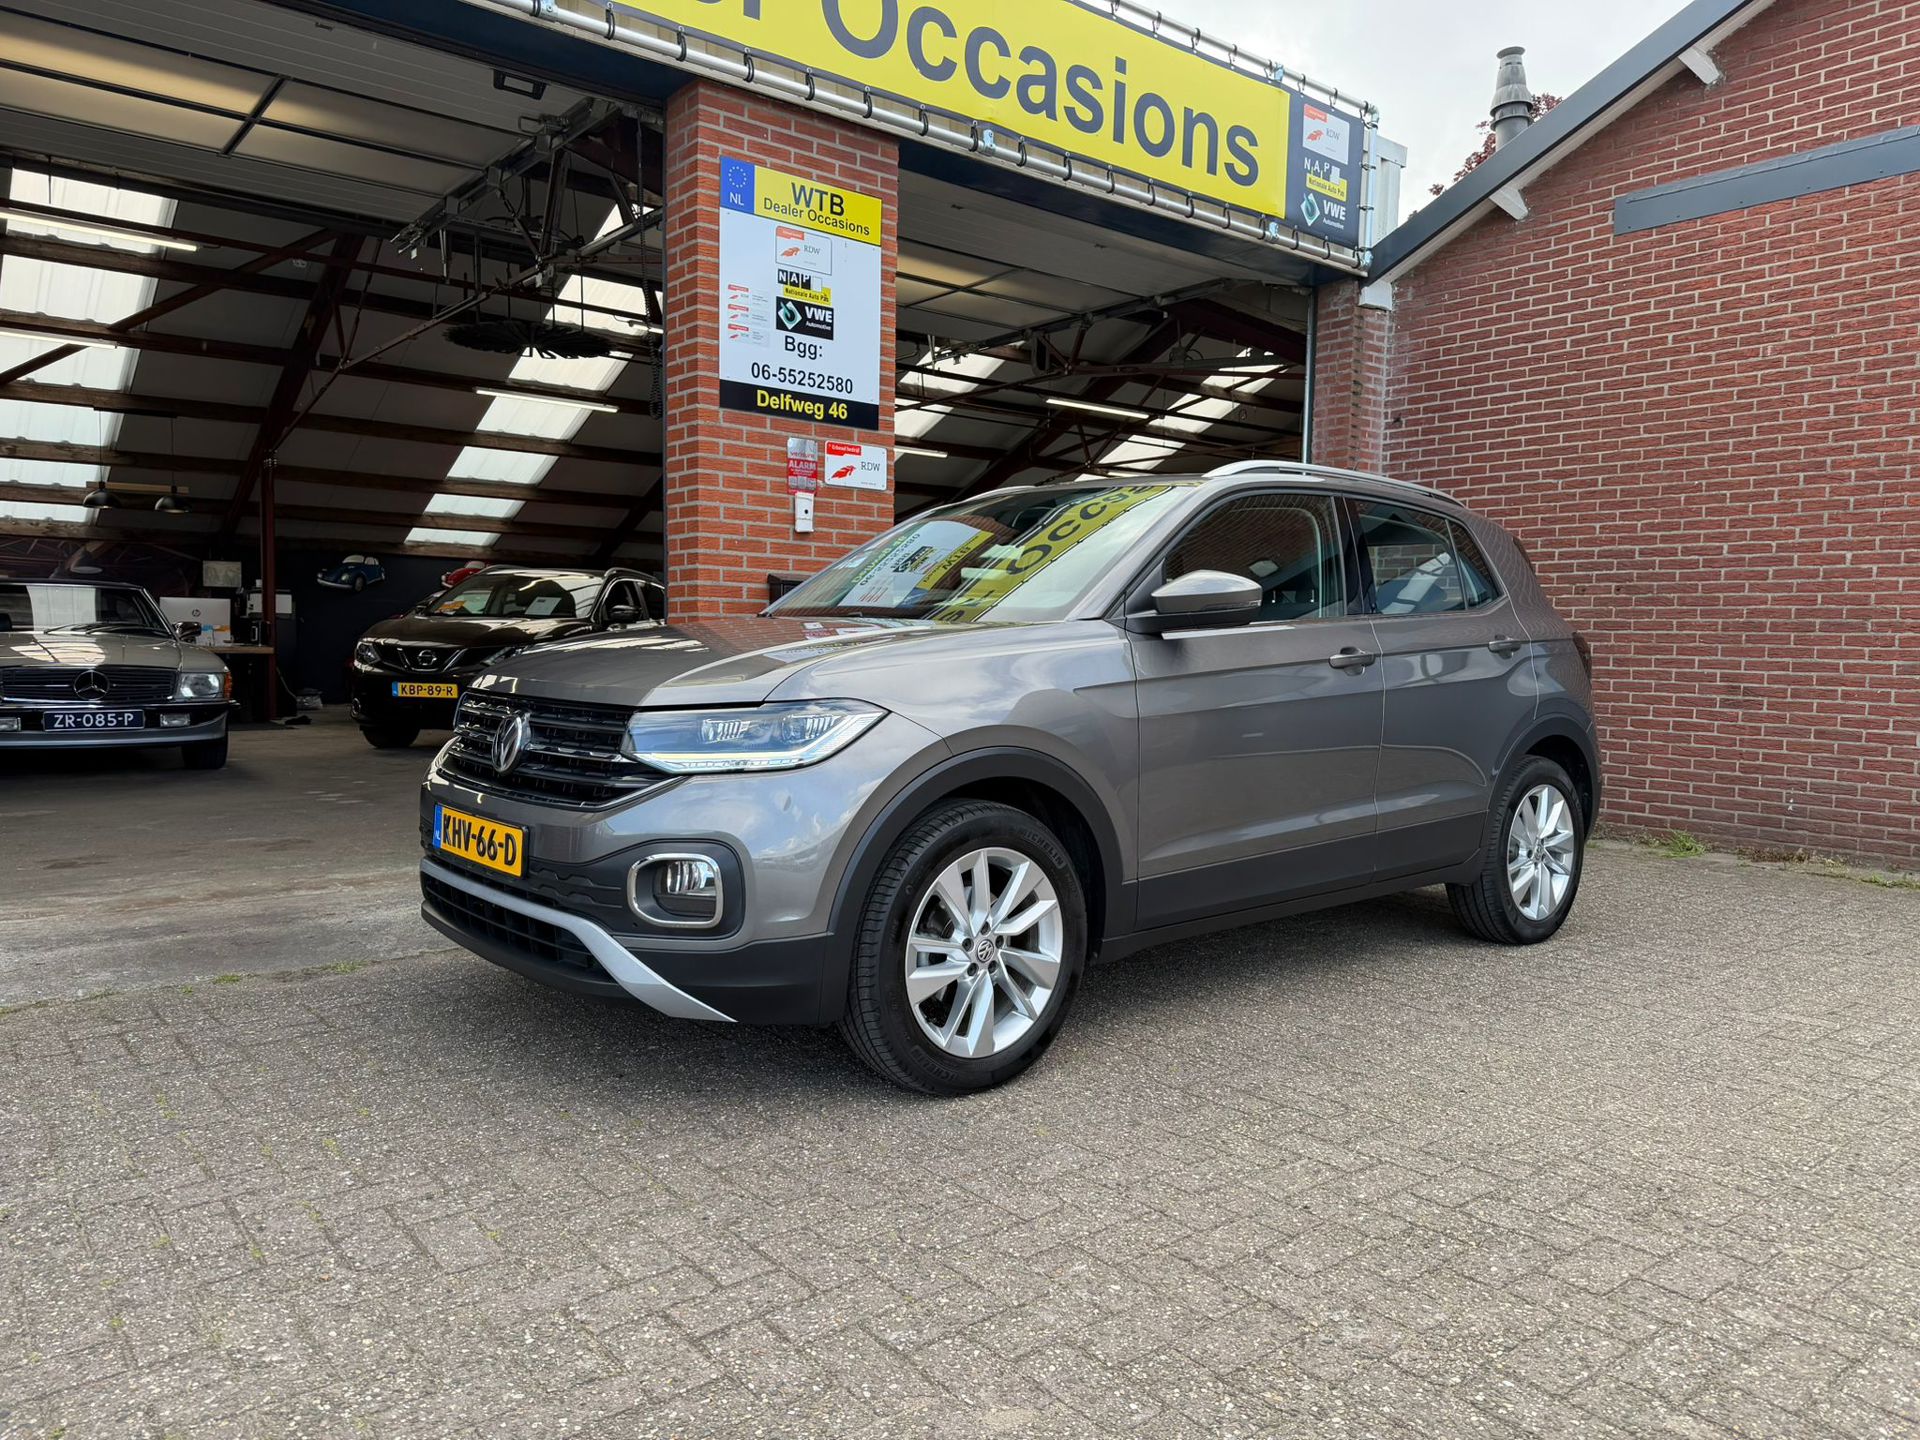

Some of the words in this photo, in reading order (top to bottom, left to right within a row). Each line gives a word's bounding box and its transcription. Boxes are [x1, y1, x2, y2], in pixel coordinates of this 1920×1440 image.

[729, 192, 744, 206] NL
[791, 182, 845, 217] WTB
[763, 197, 804, 219] Dealer
[808, 209, 870, 236] Occasions
[1323, 199, 1346, 221] VWE
[803, 244, 821, 255] RDW
[809, 292, 820, 301] Auto
[805, 306, 833, 323] VWE
[806, 321, 832, 331] Automotive
[785, 335, 823, 360] Bgg:
[751, 362, 853, 394] 06-55252580
[757, 389, 825, 420] Delfweg
[828, 402, 848, 419] 46
[788, 460, 816, 470] ALARM
[861, 461, 880, 472] RDW
[401, 684, 453, 696] KBP-89-R
[53, 713, 134, 728] ZR-085-P
[442, 813, 517, 867] KHV-66-D
